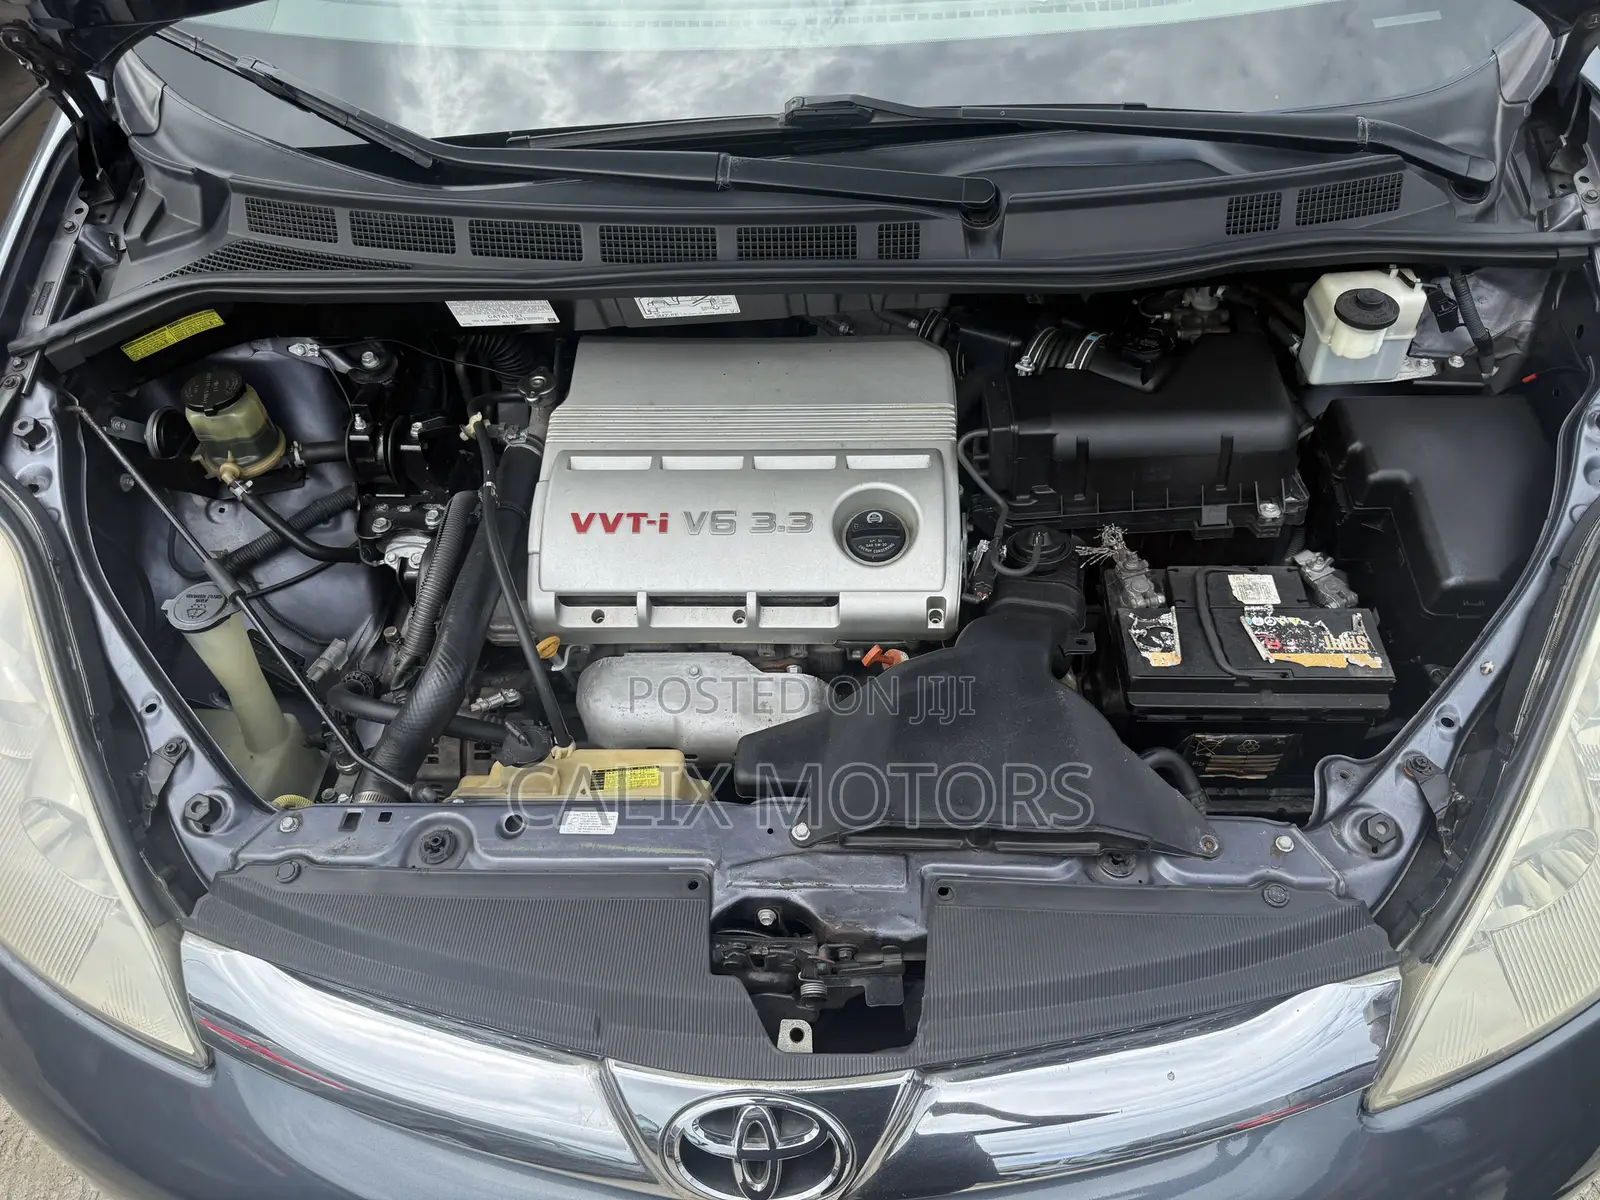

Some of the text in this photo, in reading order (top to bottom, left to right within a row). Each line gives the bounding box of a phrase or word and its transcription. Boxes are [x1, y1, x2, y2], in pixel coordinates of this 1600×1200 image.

[570, 510, 814, 536] VVT-i V6 3.3
